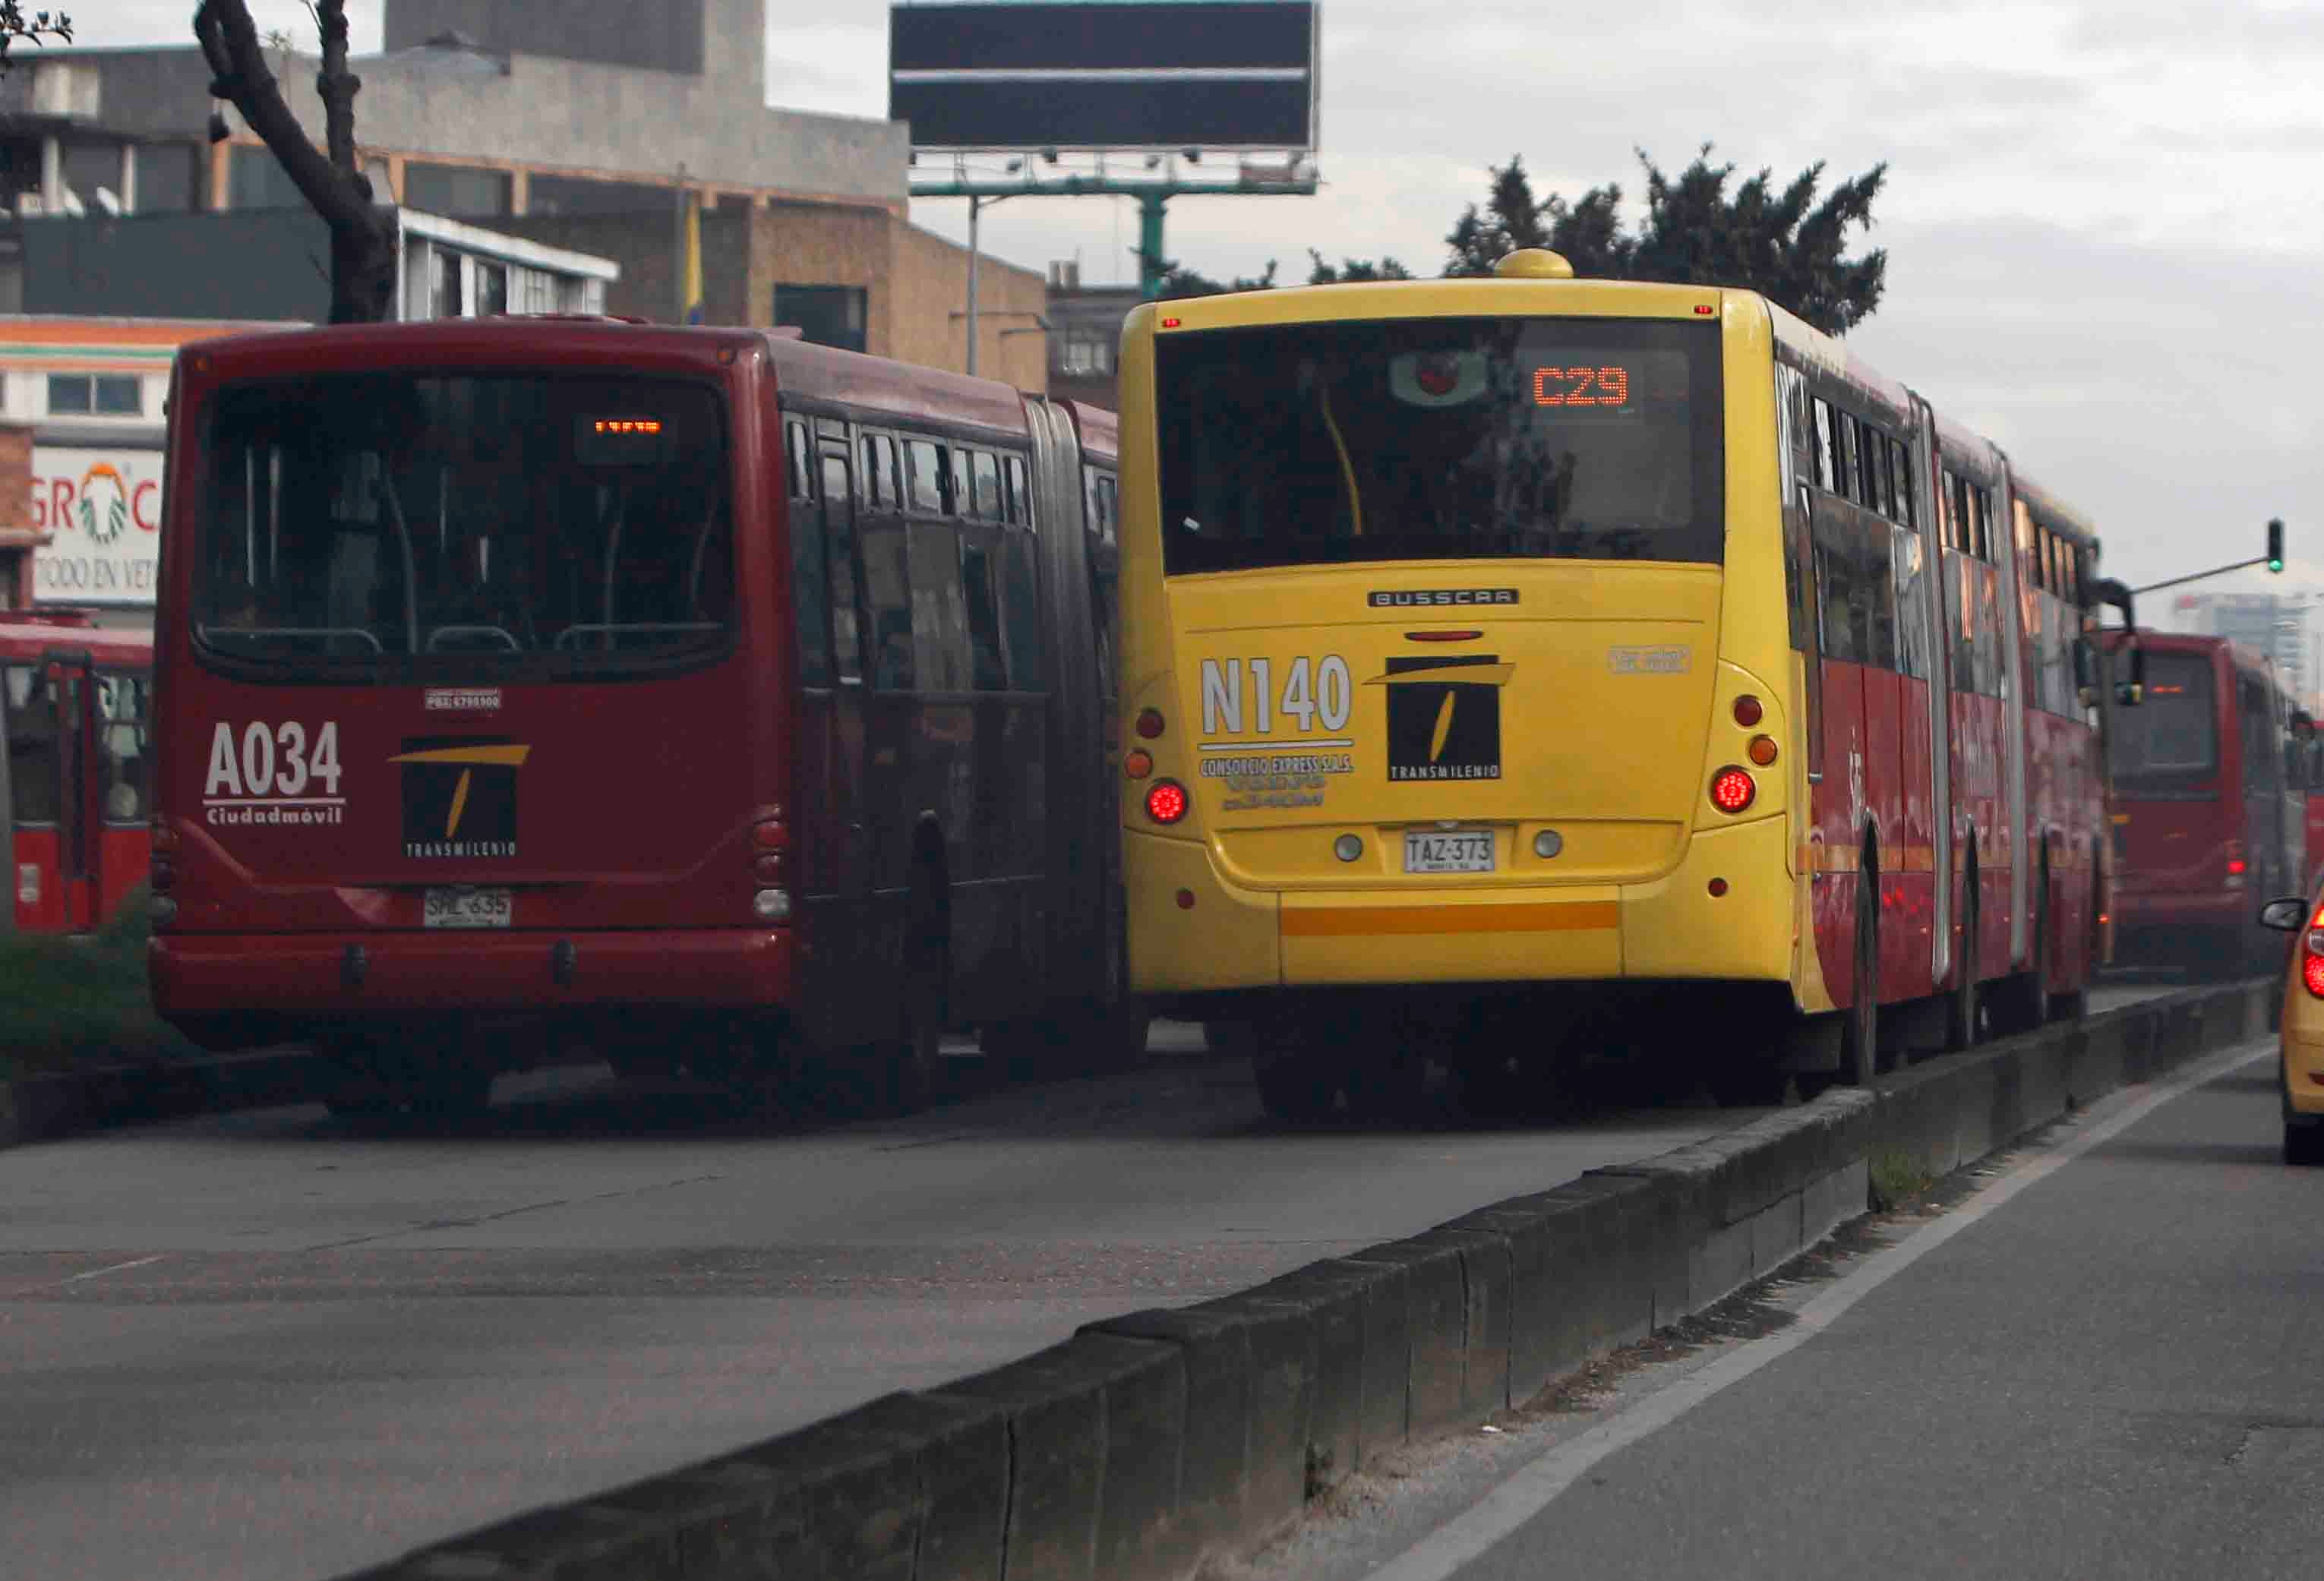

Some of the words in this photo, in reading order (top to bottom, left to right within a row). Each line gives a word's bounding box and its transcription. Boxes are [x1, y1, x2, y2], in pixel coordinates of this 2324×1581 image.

[1533, 365, 1629, 407] C29
[93, 557, 117, 589] EN
[1375, 589, 1511, 606] BUSSCAR
[1199, 654, 1351, 734] N140
[204, 721, 342, 795] A034
[1200, 758, 1268, 777] CONSORCIO
[1271, 755, 1320, 774] EXPRESS
[1390, 765, 1499, 779] TRANSMILENIO
[206, 807, 343, 825] Ciudadmóvil
[406, 842, 517, 857] TRANSMILENIO
[1407, 838, 1490, 862] TAZ-373
